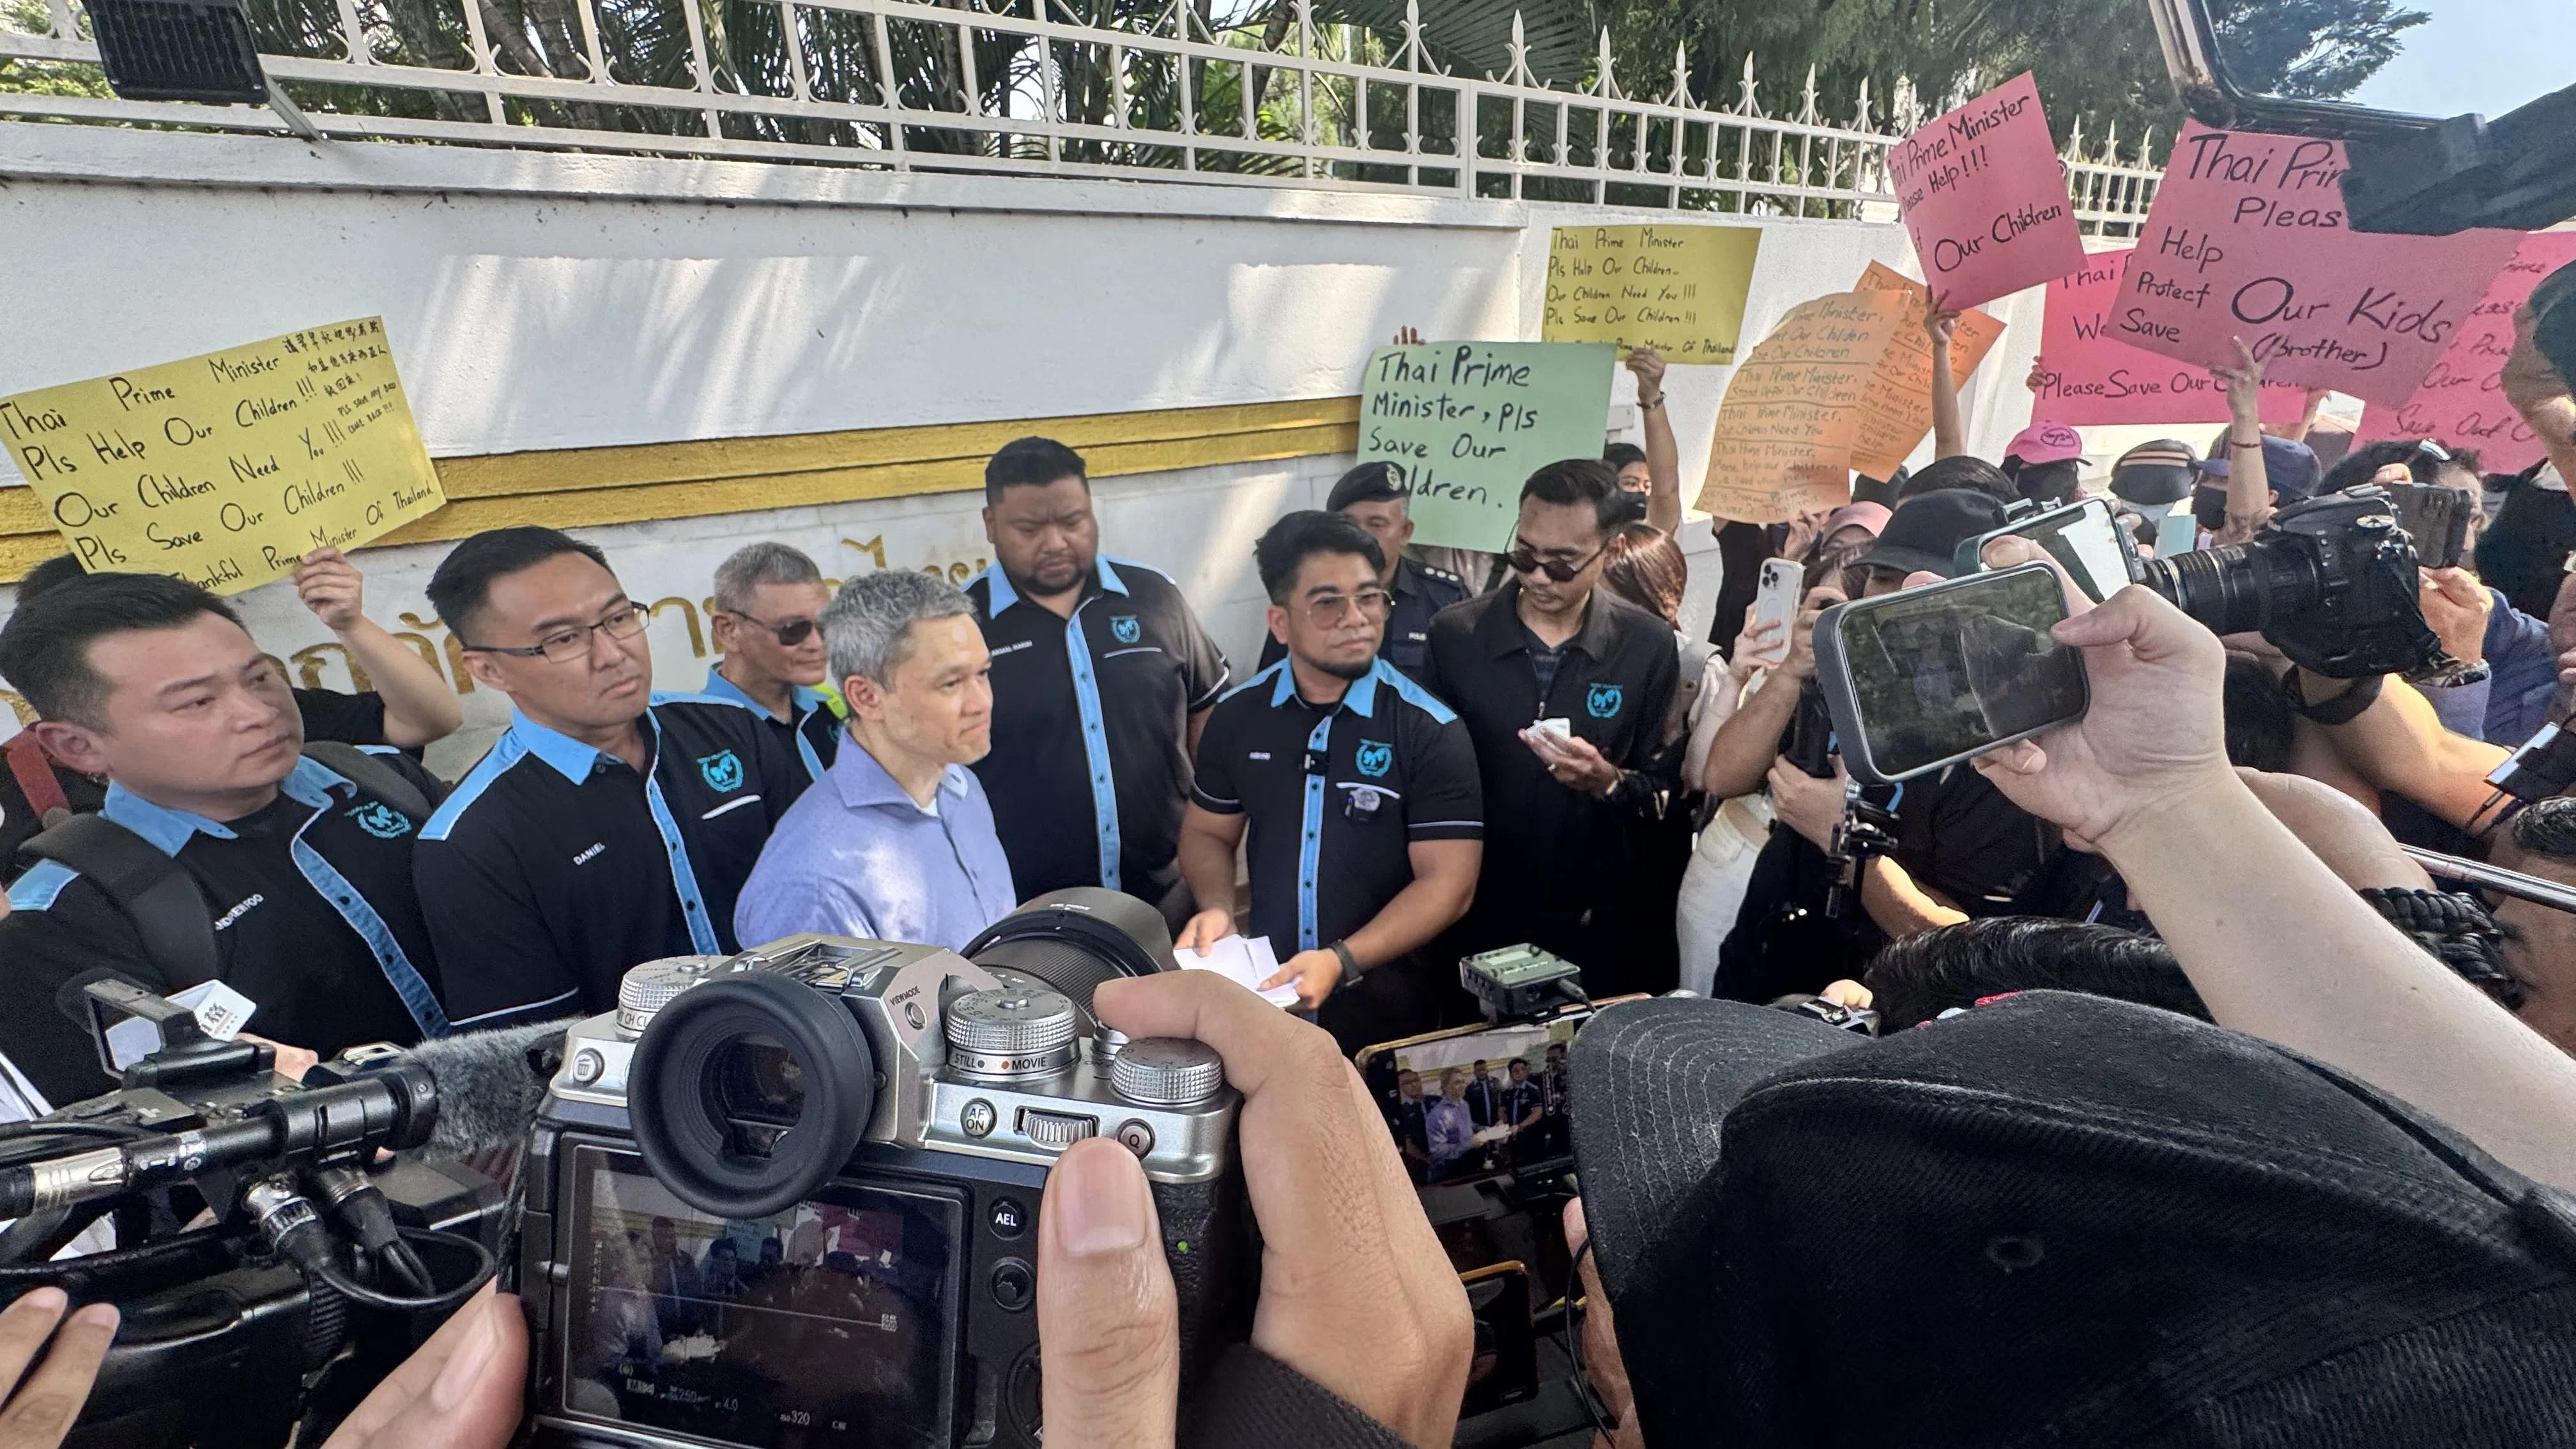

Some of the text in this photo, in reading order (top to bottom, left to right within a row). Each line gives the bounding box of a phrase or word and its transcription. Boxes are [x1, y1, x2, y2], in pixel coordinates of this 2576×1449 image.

[1907, 139, 1949, 177] Prime
[1947, 96, 2030, 151] Minister
[2188, 133, 2273, 184] Thai
[2234, 196, 2342, 229] Pleas
[1552, 227, 1684, 251] Thai Prime Minister
[1934, 236, 1985, 273] Our
[1992, 203, 2062, 243] Children
[2160, 226, 2223, 273] Help
[1548, 256, 1565, 278] Pls
[1602, 256, 1622, 275] Our
[1547, 284, 1567, 302] Our
[1573, 285, 1610, 302] Children
[1621, 285, 1647, 299] Need
[2137, 271, 2211, 309] Protect
[1574, 305, 1597, 324] Save
[1605, 305, 1626, 325] Our
[2119, 308, 2181, 343] Save
[2231, 276, 2452, 343] Our Kids
[1379, 344, 1531, 388] Thai Prime
[0, 356, 280, 440] Thai Prime Minister
[2041, 372, 2105, 399] Please
[2104, 369, 2162, 399] Save
[2170, 371, 2211, 394] Our
[20, 442, 78, 481] Pls
[86, 429, 146, 465] Help
[164, 417, 213, 446] Our
[1368, 426, 1507, 459] Save Our
[54, 491, 119, 528] Our
[137, 473, 217, 509] Children
[228, 454, 281, 486] Need
[75, 535, 127, 571] Pls
[146, 521, 204, 551] Save
[220, 502, 264, 532] Our
[262, 546, 303, 572] Prime
[309, 526, 358, 549] Minister
[365, 500, 385, 526] Of
[392, 480, 434, 511] Thailand
[574, 841, 606, 866] DANIEL
[953, 1054, 976, 1068] STILL
[1011, 1056, 1047, 1071] MOVIE
[965, 1119, 985, 1132] ON
[969, 1107, 985, 1119] AF
[1128, 1133, 1140, 1149] Q
[994, 1211, 1018, 1228] AEL
